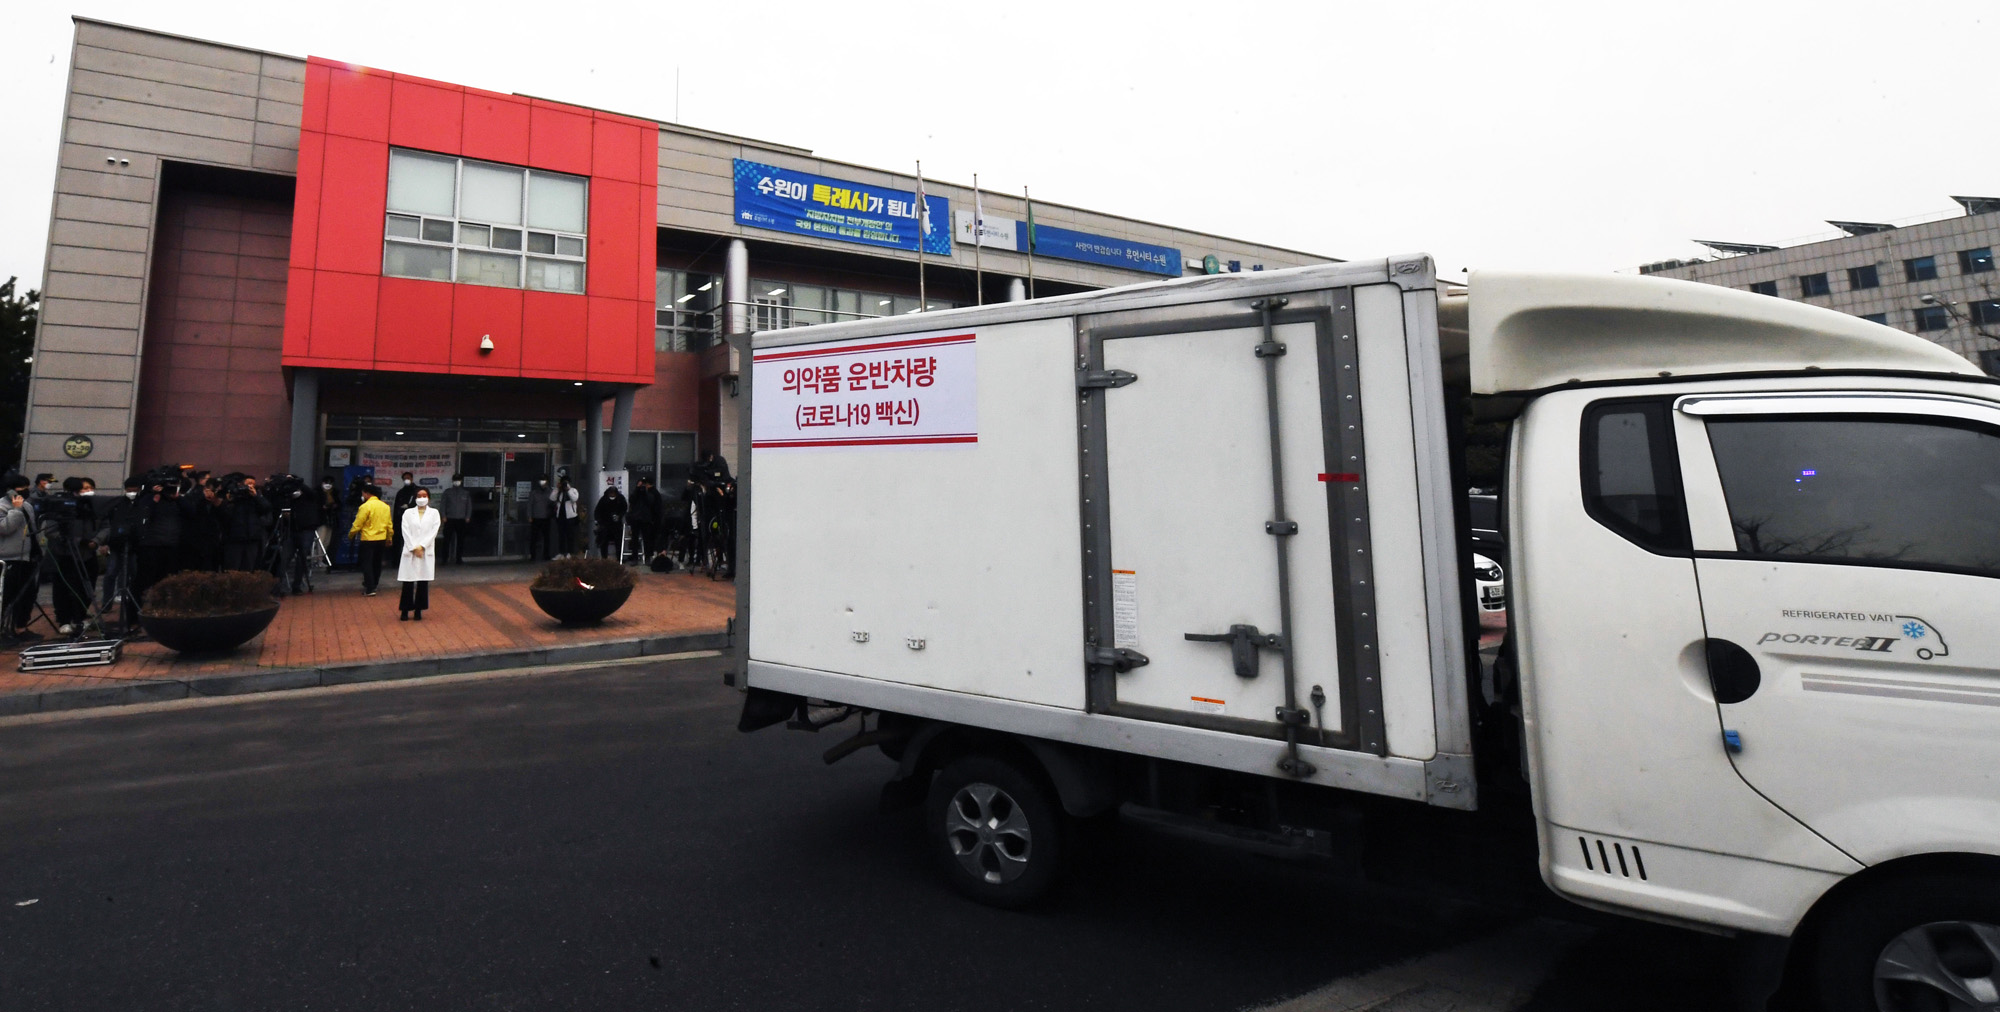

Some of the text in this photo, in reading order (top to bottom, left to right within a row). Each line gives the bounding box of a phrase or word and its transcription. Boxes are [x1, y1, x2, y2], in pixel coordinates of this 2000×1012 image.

[757, 176, 808, 202] 수원이
[812, 183, 884, 214] 특례시가
[1093, 243, 1122, 257] 반갑습니다
[1126, 248, 1152, 263] 휴먼시티
[1153, 253, 1167, 267] 수원
[782, 356, 937, 396] 의약품 운반차량
[795, 397, 920, 431] (코로나19 백신)
[1782, 609, 1866, 622] REFRIGERATED
